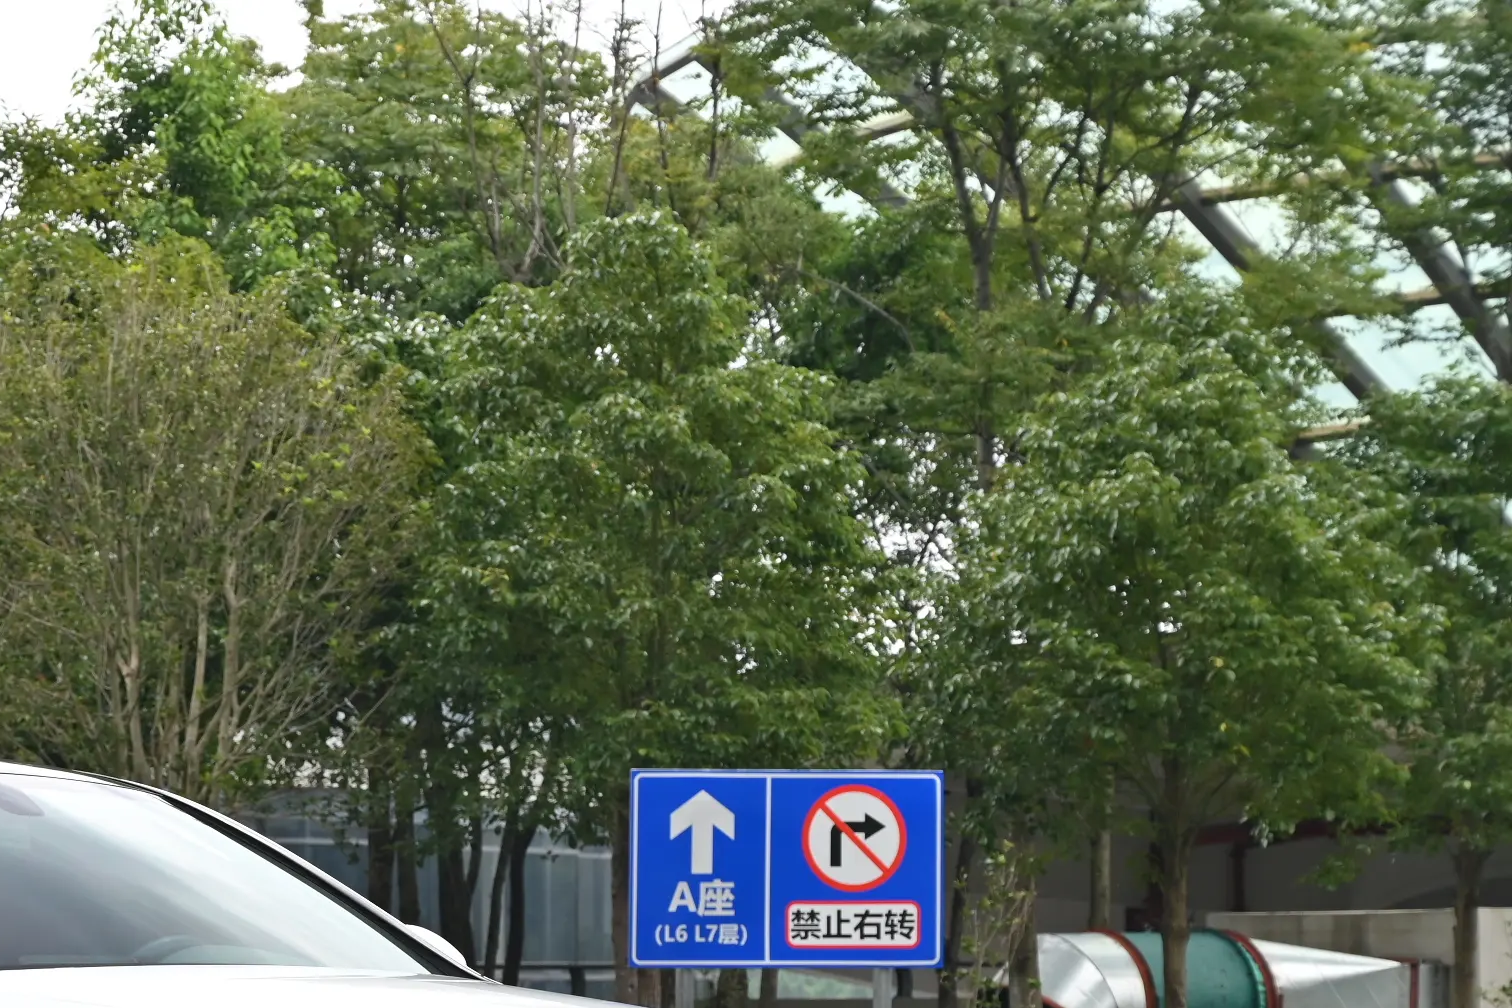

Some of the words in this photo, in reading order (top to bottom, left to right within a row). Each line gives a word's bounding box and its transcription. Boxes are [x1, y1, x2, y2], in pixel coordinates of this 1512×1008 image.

[668, 877, 736, 917] A座
[655, 924, 688, 946] (L6
[694, 923, 748, 946] L7层)
[790, 909, 915, 940] 禁止右转
